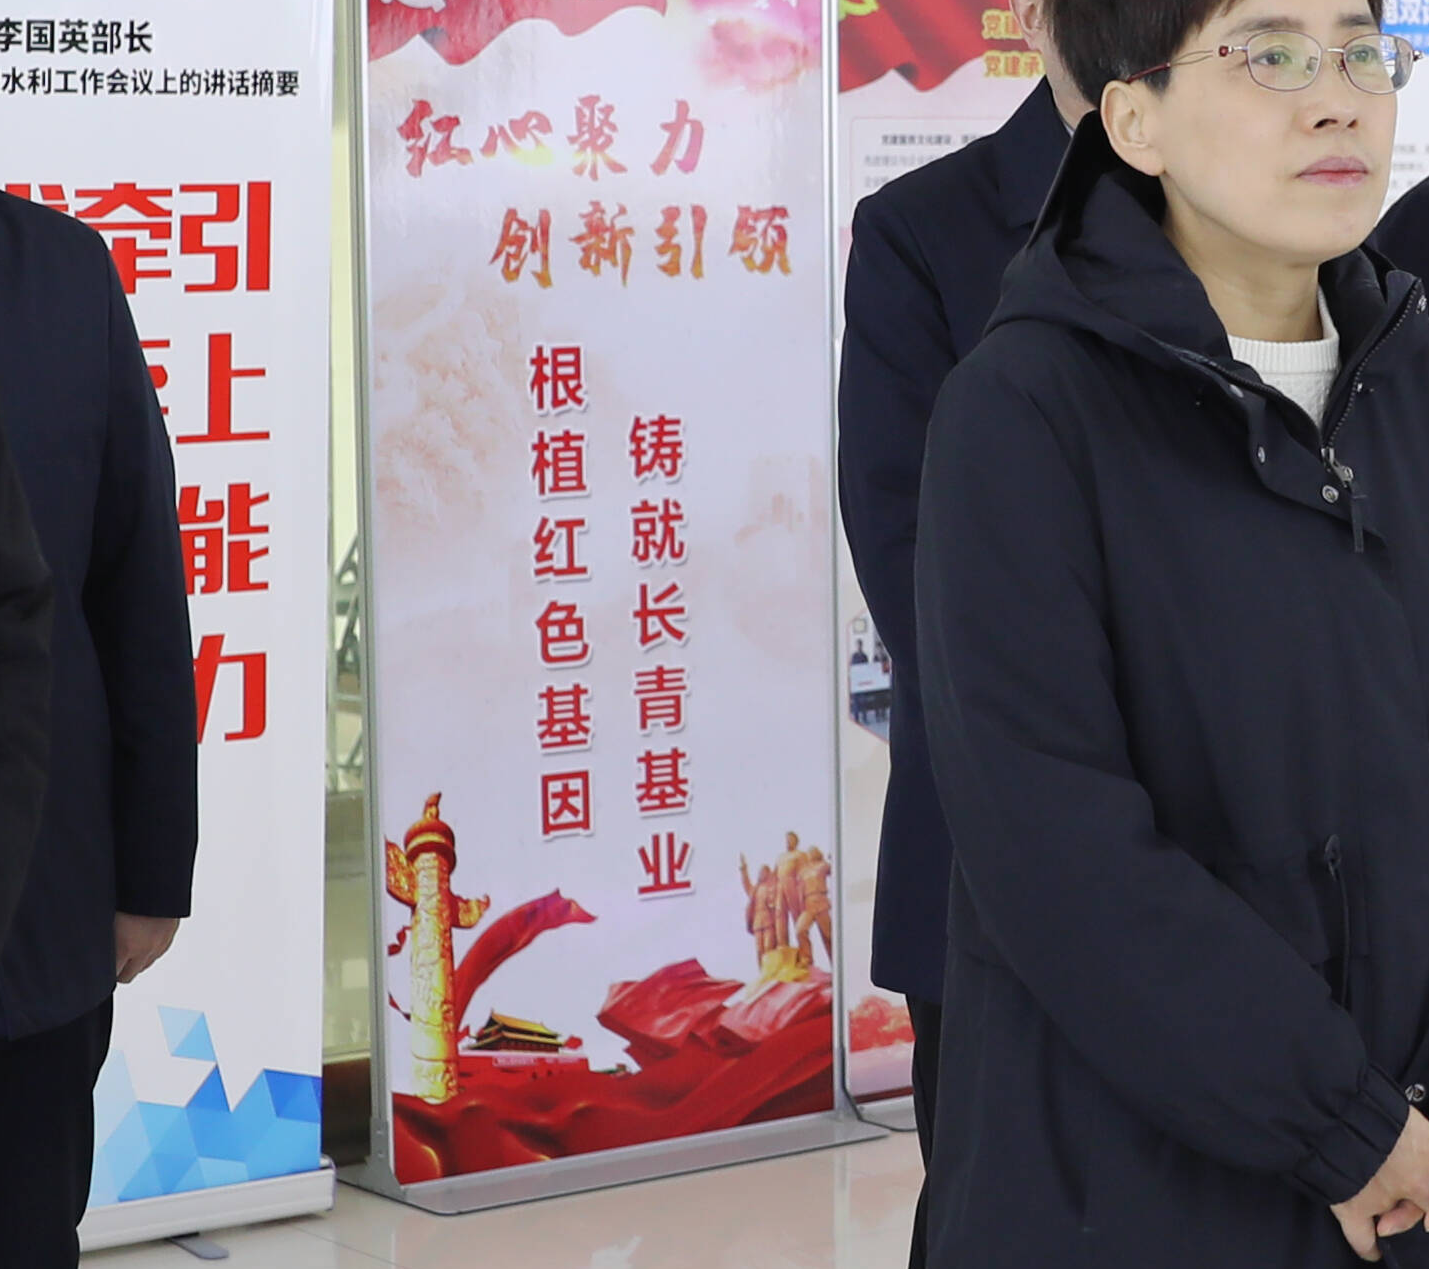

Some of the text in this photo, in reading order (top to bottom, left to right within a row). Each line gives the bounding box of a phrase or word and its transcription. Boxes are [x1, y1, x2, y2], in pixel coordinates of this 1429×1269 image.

[398, 94, 705, 182] 红心聚力
[4, 181, 271, 293] 牵引
[490, 200, 793, 288] 创新引领
[137, 332, 270, 445] 上
[529, 344, 592, 837] 根植红色基因
[629, 414, 691, 897] 铸就长青基业
